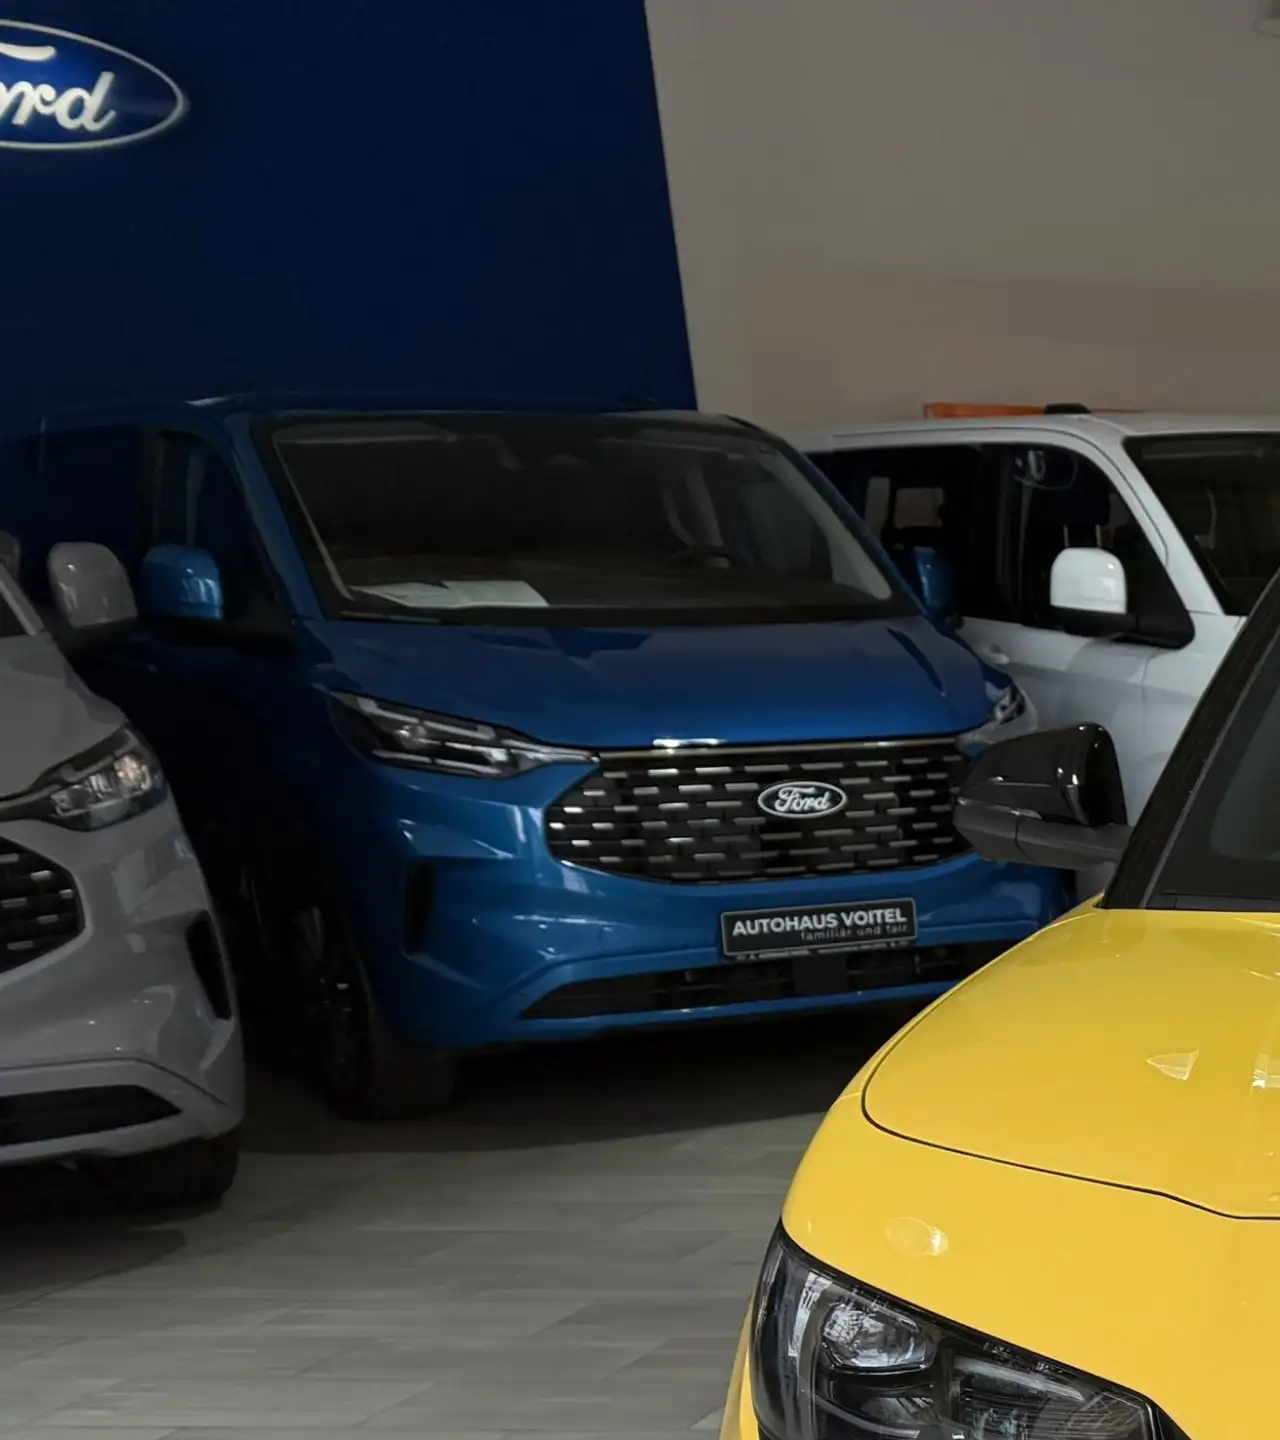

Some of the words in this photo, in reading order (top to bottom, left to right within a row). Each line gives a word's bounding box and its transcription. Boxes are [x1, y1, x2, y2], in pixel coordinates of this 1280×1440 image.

[0, 42, 117, 132] rd
[774, 787, 831, 811] Ford
[732, 913, 839, 937] AUTOHAUS
[841, 907, 907, 926] VOITEL
[857, 925, 881, 936] und
[887, 923, 908, 933] fair
